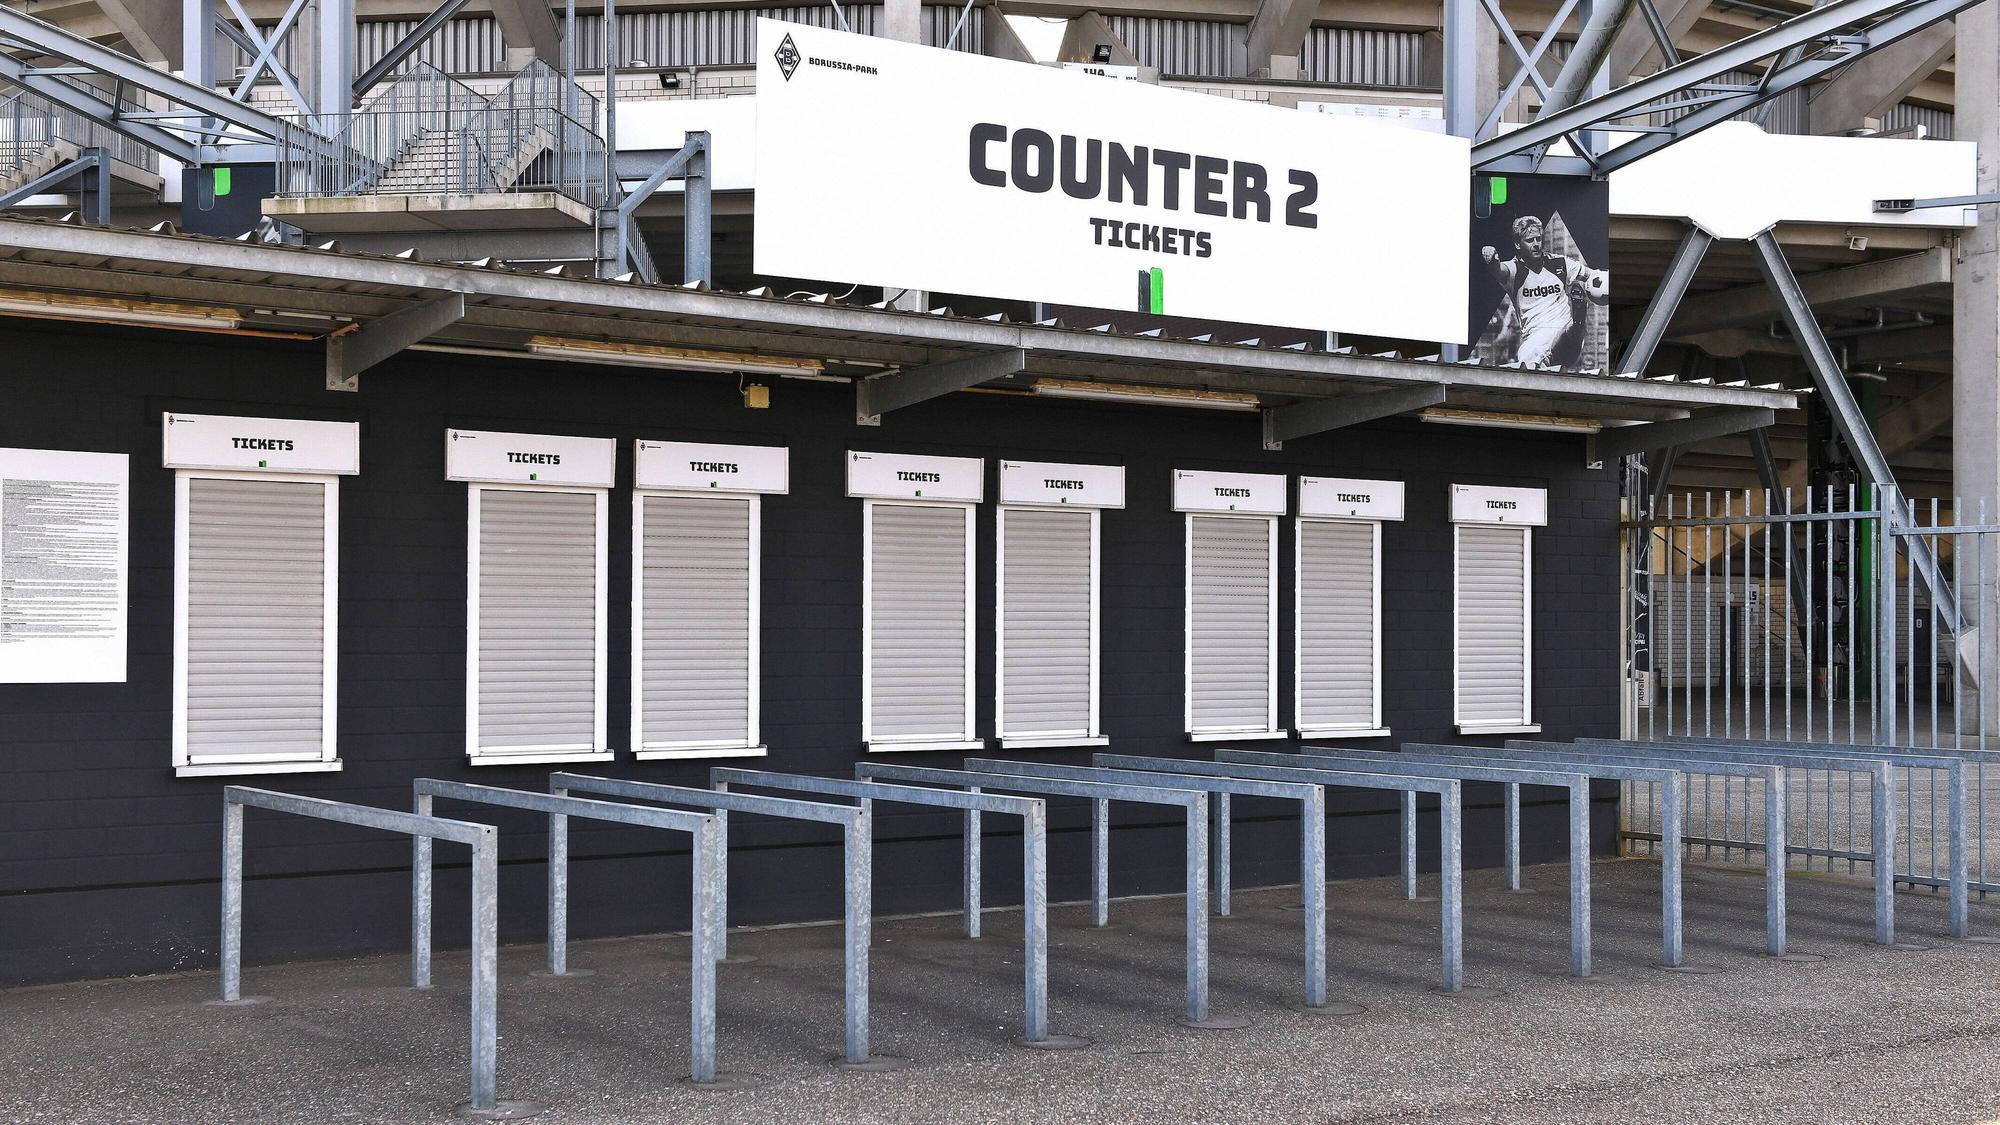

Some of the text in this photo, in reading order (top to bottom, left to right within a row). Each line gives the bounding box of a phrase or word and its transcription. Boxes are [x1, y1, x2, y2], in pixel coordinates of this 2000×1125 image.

[809, 57, 878, 75] BORUSSIA-PARK
[969, 122, 1318, 229] COUNTER 2
[1090, 216, 1212, 258] TICKETS
[1522, 282, 1561, 300] erdgas
[231, 437, 294, 451] TICKETS
[506, 451, 561, 465] TICKETS
[689, 461, 739, 474] TICKETS
[896, 471, 941, 483] TICKETS
[1043, 479, 1084, 490] TICKETS
[1214, 487, 1251, 498] TICKETS
[1336, 493, 1371, 504] TICKETS
[1485, 500, 1517, 510] TICKETS
